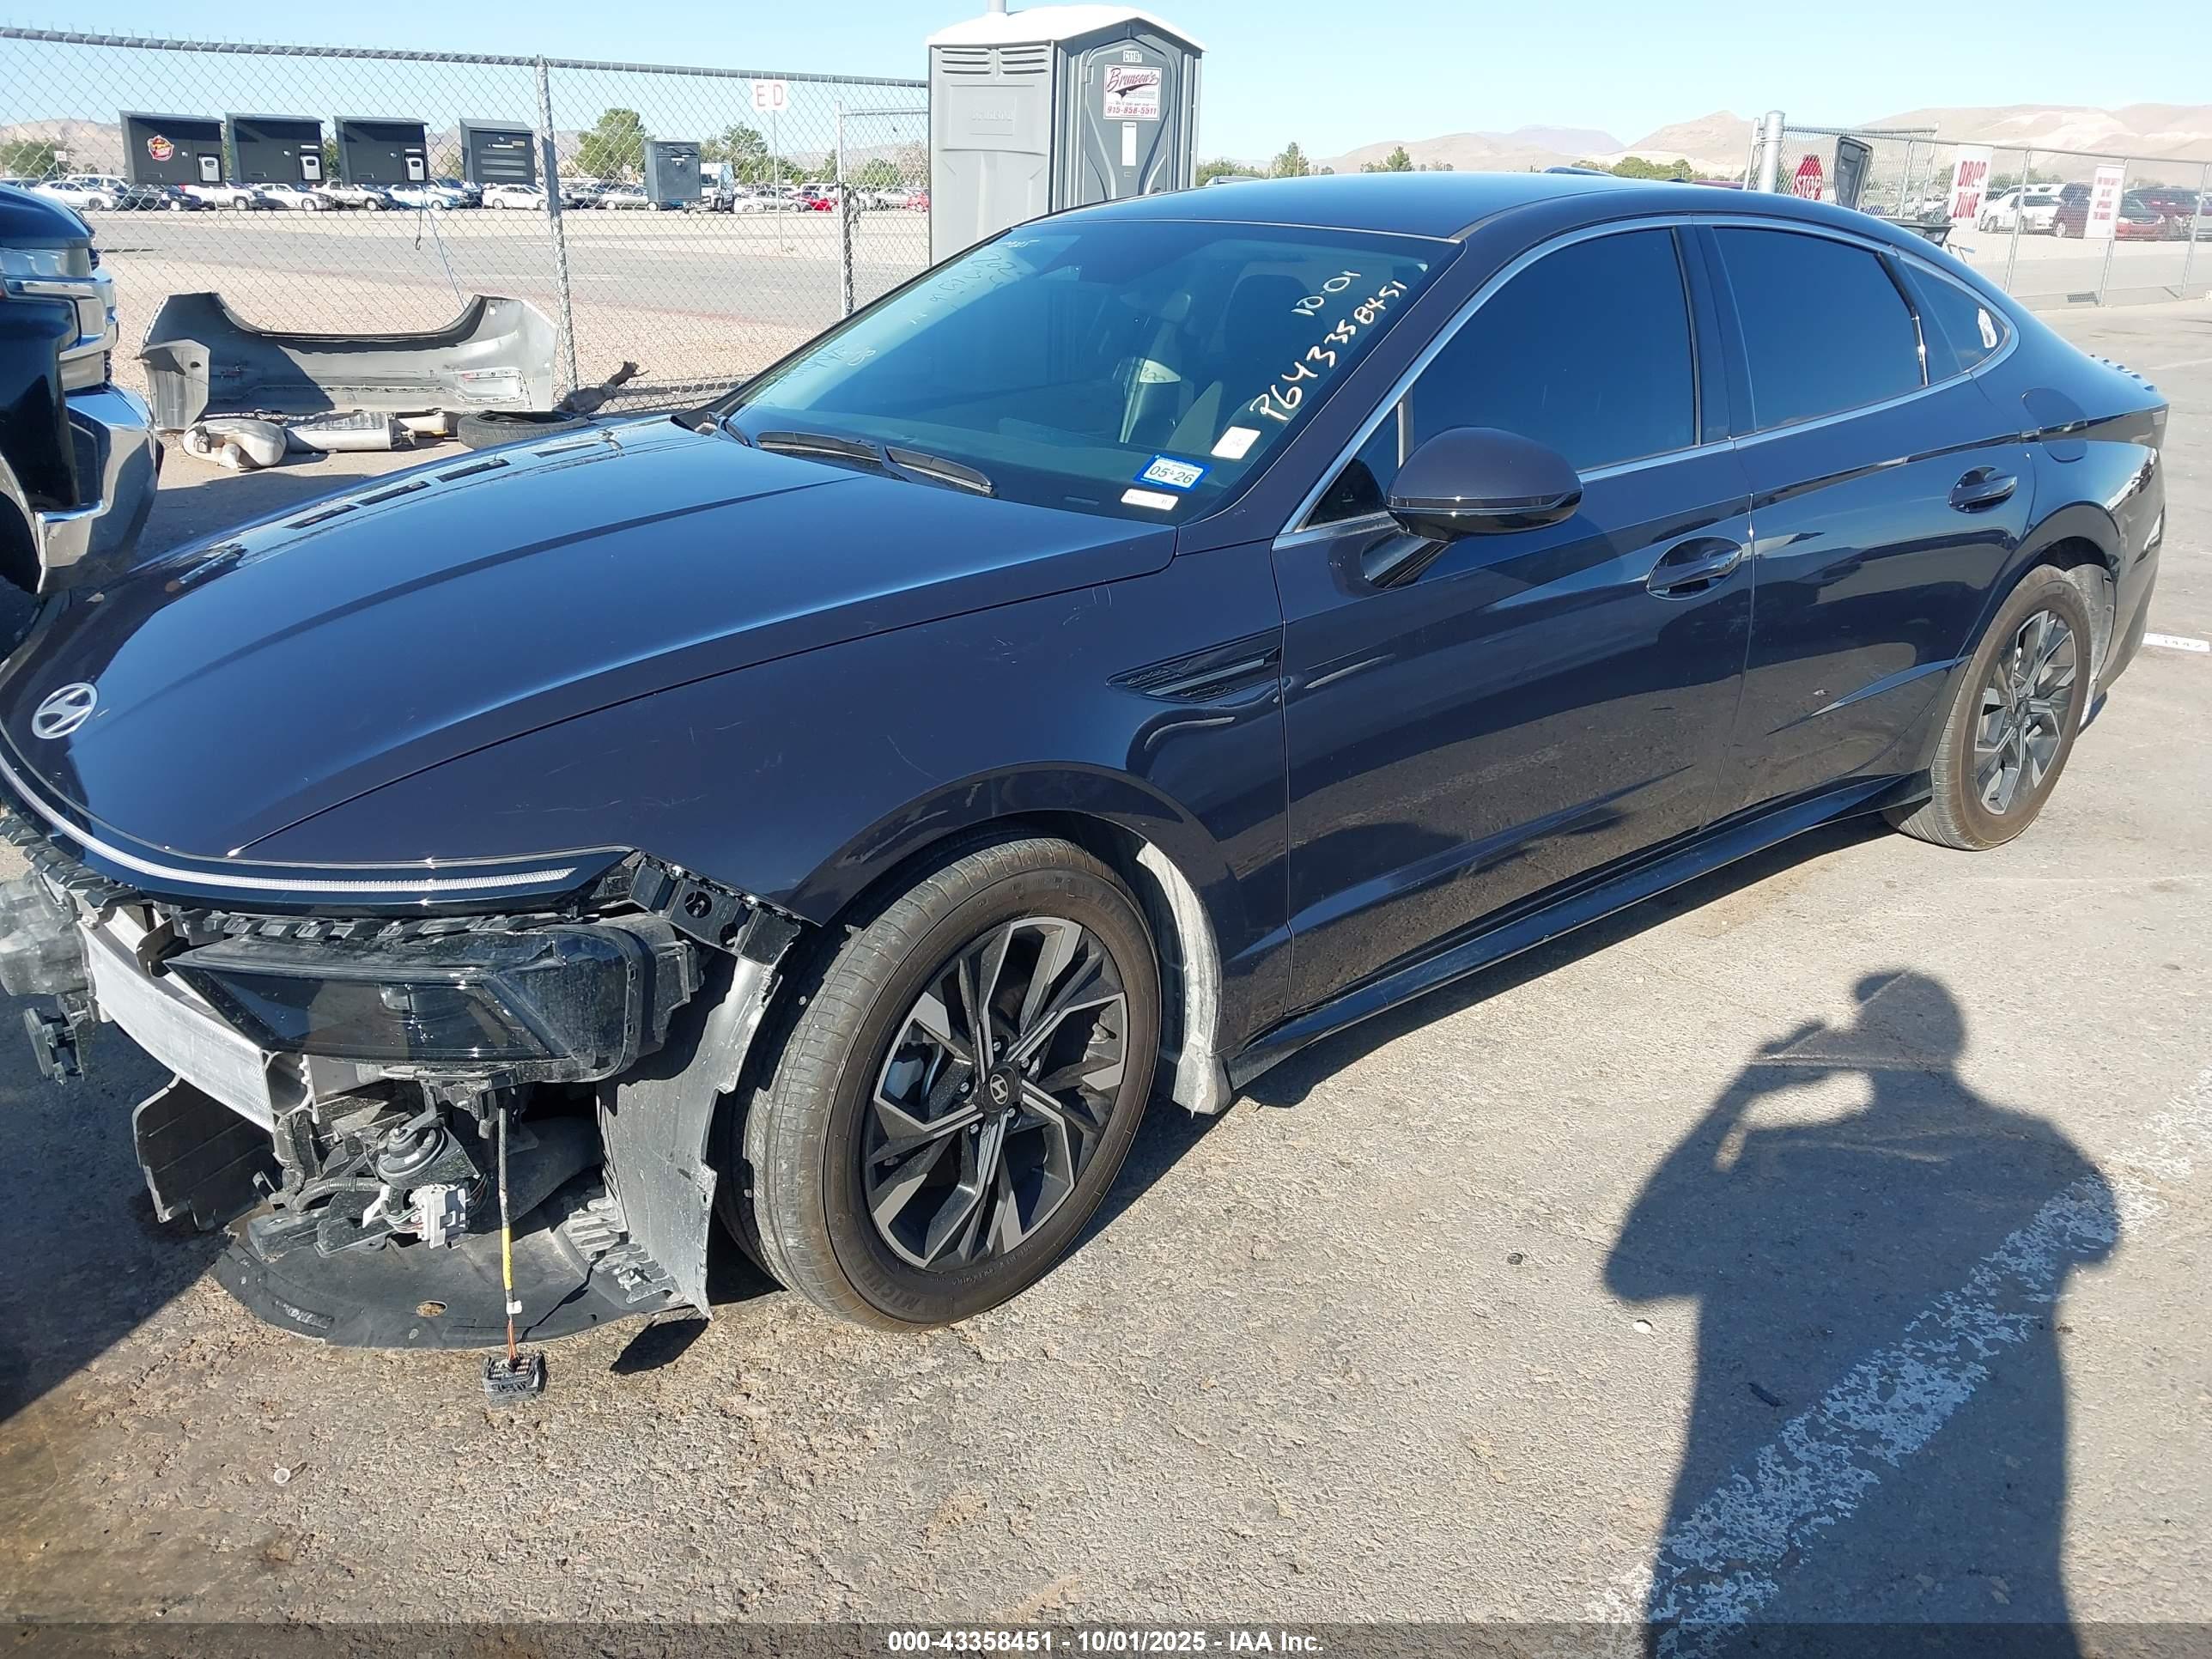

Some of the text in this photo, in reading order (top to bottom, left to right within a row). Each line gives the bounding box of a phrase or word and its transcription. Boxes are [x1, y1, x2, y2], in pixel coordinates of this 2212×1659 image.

[1795, 174, 1822, 201] STOP
[1957, 160, 1987, 188] DROP
[1952, 191, 1981, 218] ZONE
[1149, 465, 1171, 478] 05
[1173, 471, 1196, 484] 26
